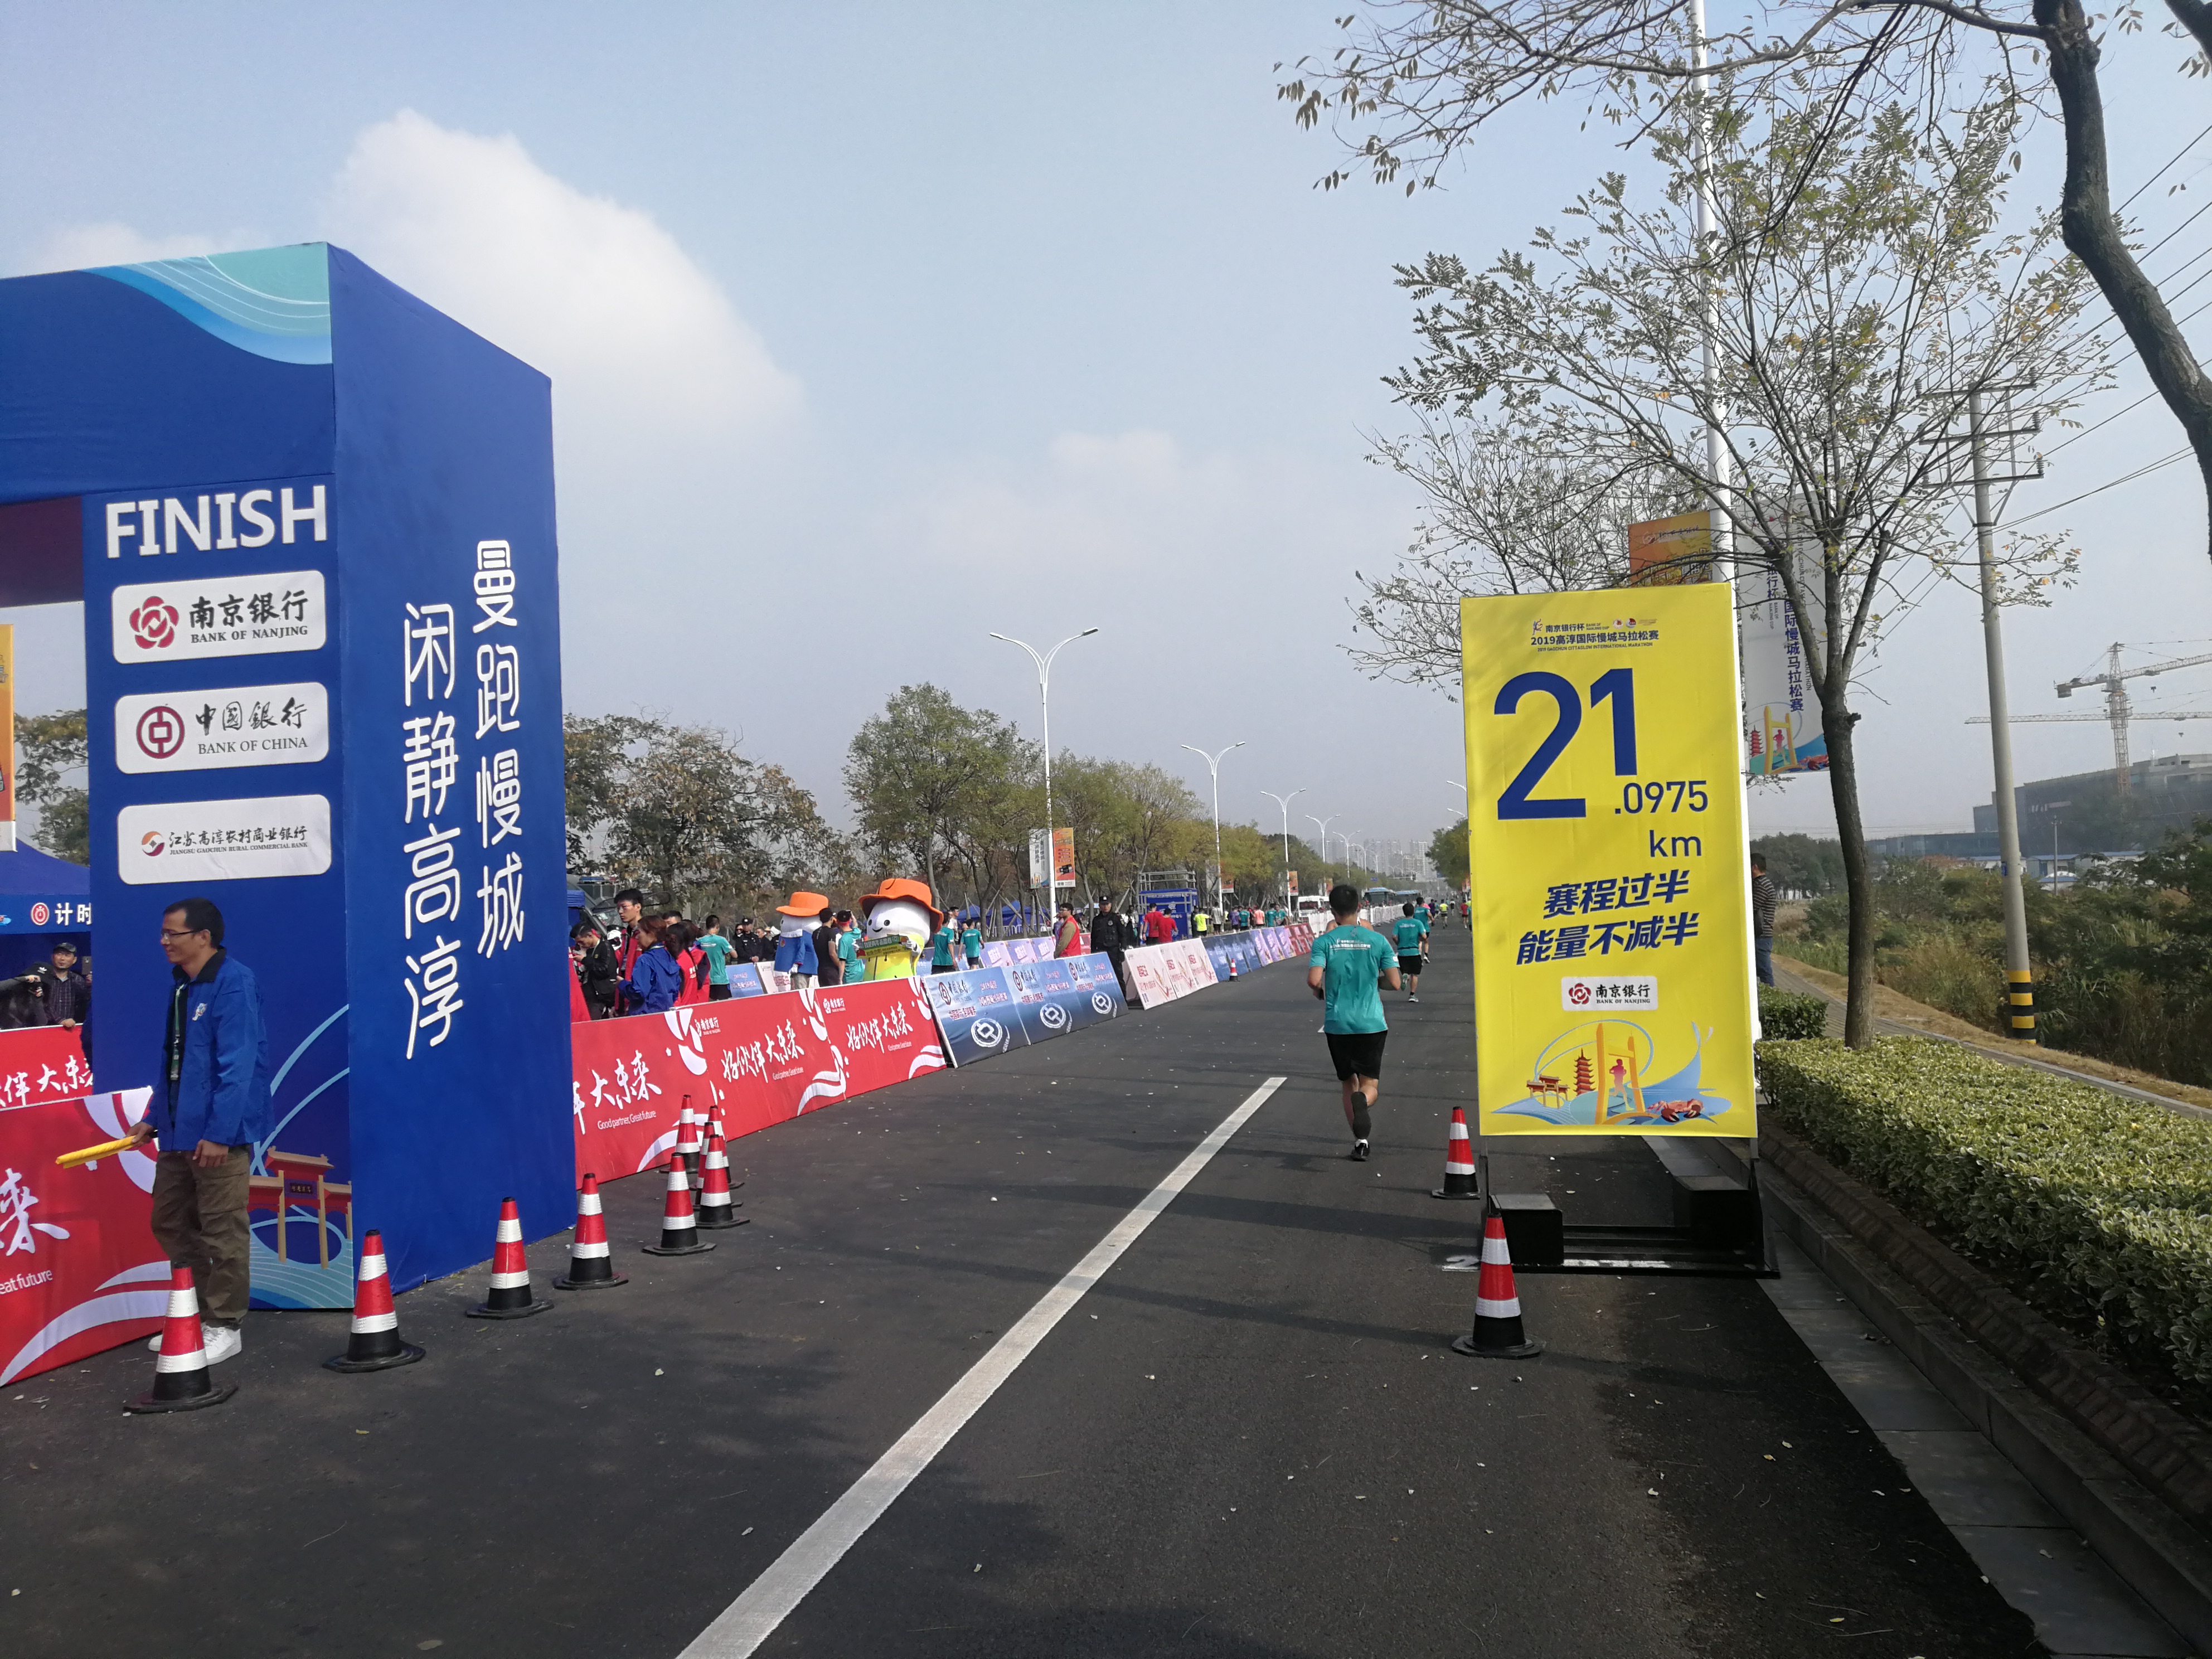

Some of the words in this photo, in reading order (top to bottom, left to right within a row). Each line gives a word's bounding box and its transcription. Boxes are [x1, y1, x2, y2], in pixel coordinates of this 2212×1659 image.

[106, 485, 327, 559] FINISH
[189, 589, 308, 630] 南京银行
[191, 632, 227, 644] BANK
[231, 630, 248, 641] OF
[253, 625, 308, 639] NANJING
[1530, 629, 1660, 646] 2019高淳国际慢城马拉松赛
[1545, 623, 1585, 633] 南京银行杯
[198, 741, 236, 755] BANK
[240, 740, 258, 752] OF
[261, 737, 308, 750] CHINA
[472, 539, 525, 959] 曼跑慢城
[401, 601, 463, 1060] 闲静高淳
[1649, 829, 1702, 858] km
[250, 842, 290, 851] COMMERCIAL
[1542, 869, 1690, 920] 赛程过半
[1516, 911, 1700, 966] 能量不减半
[1595, 983, 1651, 998] 南京银行
[597, 1118, 613, 1130] Good
[612, 1117, 631, 1129] partner,
[629, 1113, 643, 1123] Great
[641, 1110, 657, 1120] future
[0, 1168, 70, 1257] 来
[0, 1277, 20, 1295] eat
[17, 1269, 54, 1289] future
